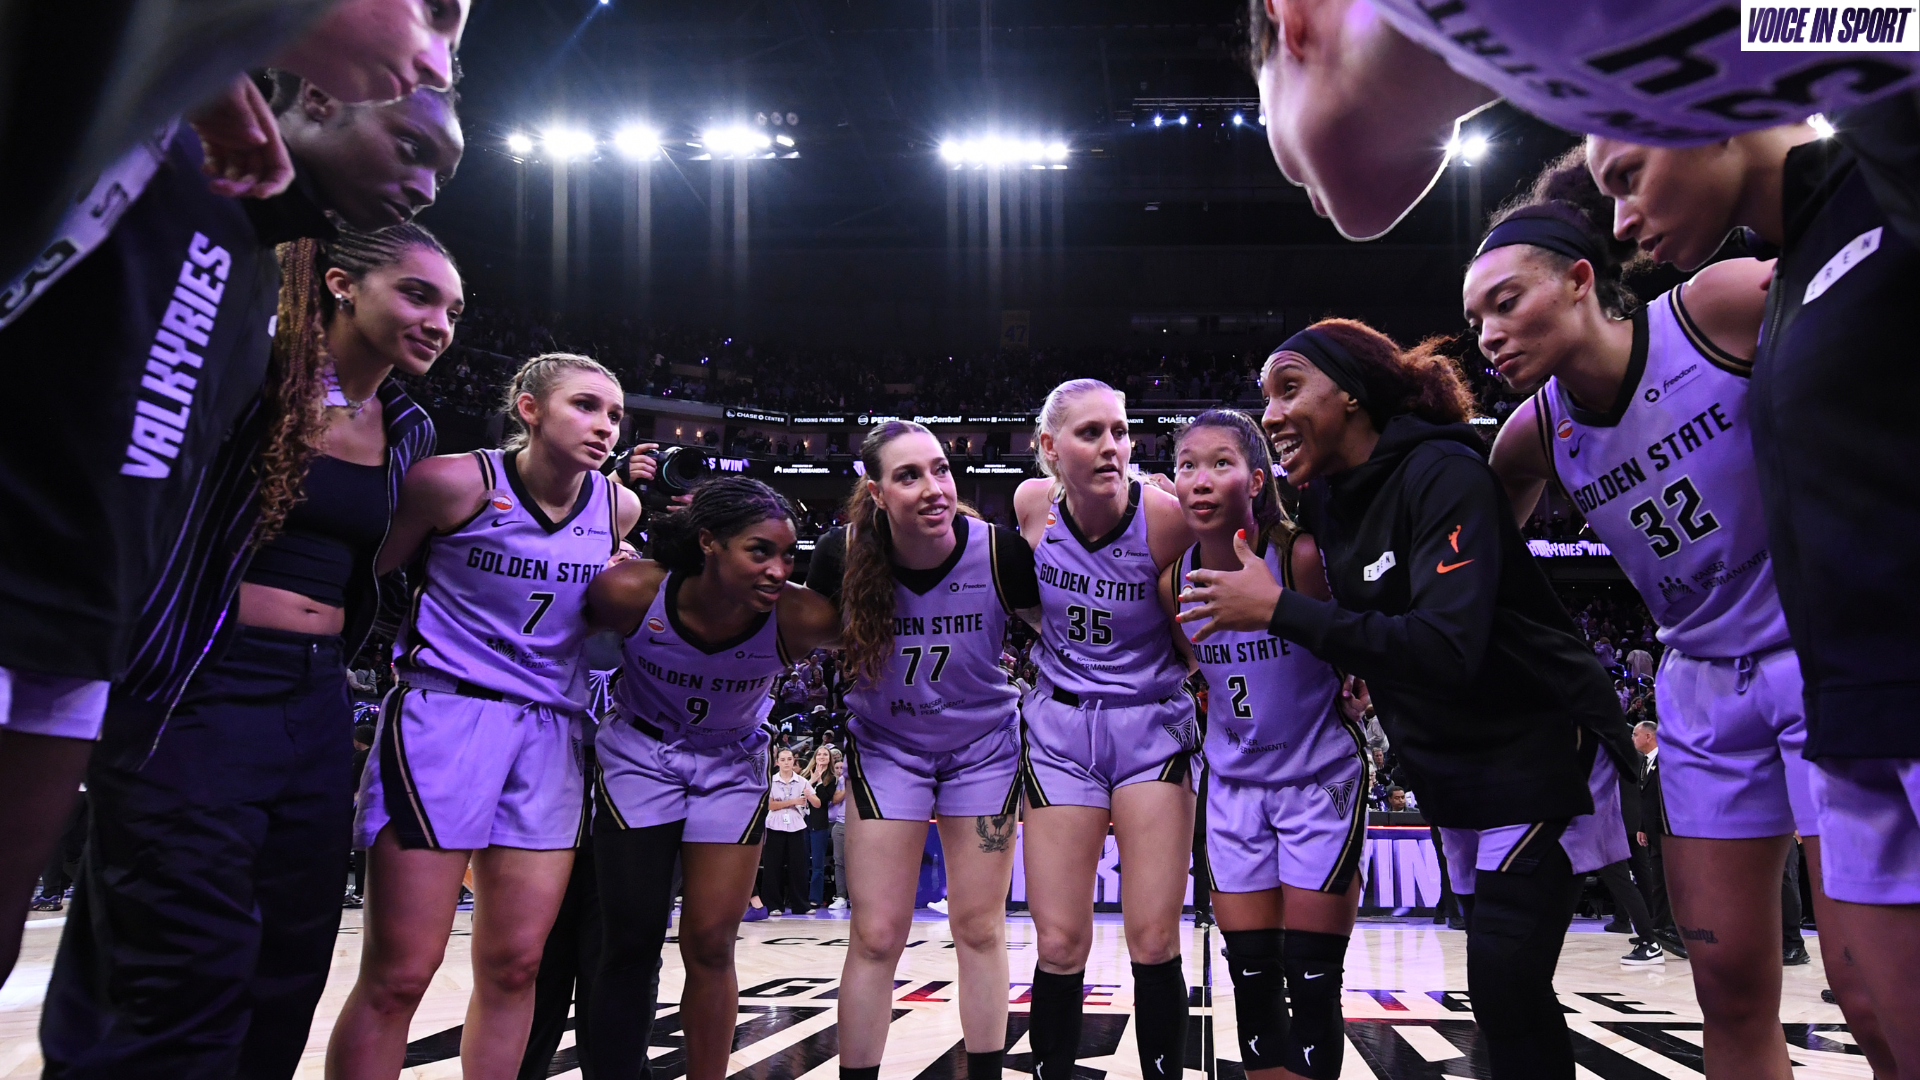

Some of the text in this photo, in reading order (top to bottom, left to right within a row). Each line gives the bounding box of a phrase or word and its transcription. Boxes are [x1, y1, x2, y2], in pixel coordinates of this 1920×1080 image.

[1004, 325, 1026, 342] 47
[119, 230, 232, 479] VALKYRIES
[1662, 363, 1698, 393] freedom
[764, 415, 785, 423] CENTER
[913, 416, 962, 425] RingCentral
[1157, 416, 1188, 424] CHASE
[1468, 416, 1498, 425] verizon
[719, 457, 744, 472] WIN
[1573, 402, 1733, 514] GOLDEN STATE
[1628, 474, 1722, 560] 32
[466, 546, 548, 581] GOLDEN
[1124, 549, 1149, 558] freedom
[1039, 562, 1146, 601] GOLDEN STATE
[1691, 560, 1727, 582] KAISER
[961, 582, 987, 592] freedom
[520, 591, 556, 636] 7
[893, 612, 983, 636] DEN STATE
[1066, 604, 1113, 646] 35
[1236, 636, 1291, 663] STATE
[638, 655, 768, 693] GOLDEN STATE
[900, 644, 951, 687] 77
[685, 696, 710, 726] 9
[1226, 674, 1253, 719] 2
